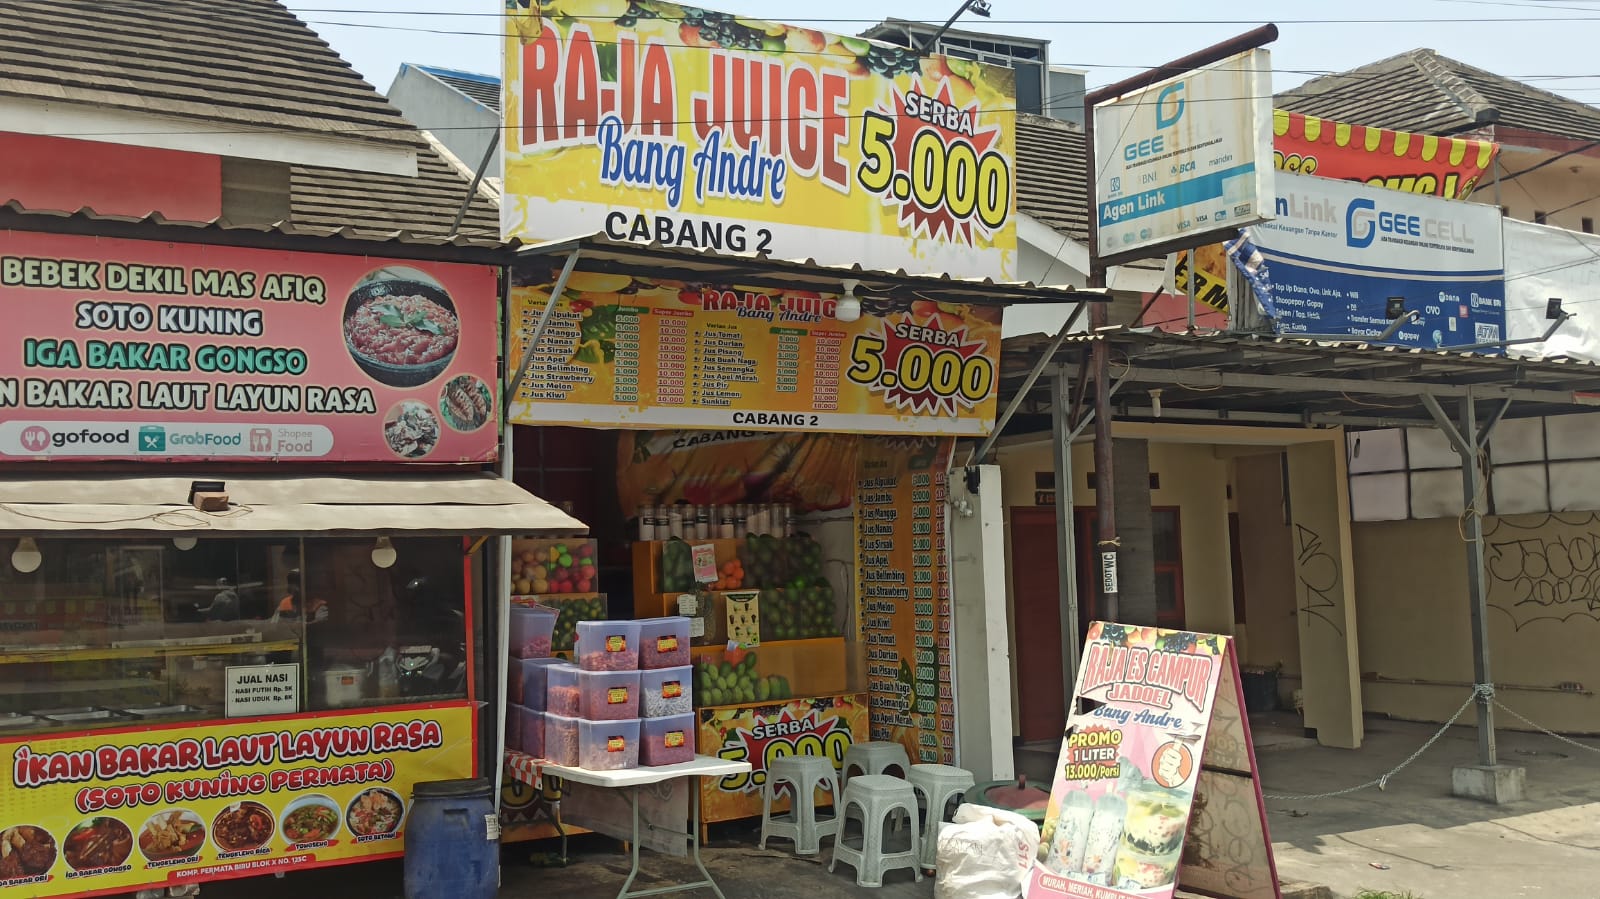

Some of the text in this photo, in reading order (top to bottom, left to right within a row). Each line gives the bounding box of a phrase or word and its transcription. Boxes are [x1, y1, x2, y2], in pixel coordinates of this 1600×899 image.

[522, 26, 850, 192] RAJA JUICE
[906, 91, 974, 136] SERBA
[1124, 135, 1164, 161] GEE
[600, 116, 785, 207] Bang Andre
[1179, 161, 1196, 174] BCA
[1209, 154, 1232, 166] mandiri
[858, 110, 1010, 229] 5.000
[1142, 172, 1157, 184] BNI
[1104, 191, 1165, 220] Agen Link
[605, 211, 772, 254] CABANG 2
[1177, 220, 1190, 230] VISA
[1279, 225, 1304, 233] Keuangan
[1305, 228, 1320, 237] Tanpa
[1379, 211, 1474, 244] GEE CELL
[2, 258, 327, 304] BEBEK DEKIL MAS AFIQ
[1276, 283, 1284, 293] Top
[702, 291, 771, 311] RAJA
[1479, 297, 1492, 306] BANK
[736, 306, 821, 323] Bang Andre
[1426, 305, 1440, 315] OVO
[76, 302, 262, 336] SOTO KUNING
[548, 320, 575, 328] Jambu
[547, 329, 581, 338] Mangga
[894, 322, 961, 348] SERBA
[1404, 332, 1419, 341] gopay
[24, 340, 308, 375] IGA BAKAR GONGSO
[547, 365, 589, 373] Belimbing
[847, 336, 992, 402] 5.000
[547, 374, 594, 383] Strawberry
[24, 380, 376, 413] BAKAR LAUT LAYUN RASA
[733, 412, 819, 426] CABANG 2
[52, 428, 313, 447] gofood GrabFood Shopee
[277, 439, 313, 453] Food
[875, 509, 897, 521] Mangga
[866, 571, 905, 584] Jus Belimbing
[1104, 554, 1114, 591] SEDOT WC
[866, 586, 909, 598] Jus Strawberry
[867, 602, 895, 613] Jus Melon
[868, 634, 895, 644] Jus Tomat
[878, 650, 898, 660] Durian
[237, 673, 288, 684] JUAL NASI
[869, 665, 898, 679] Jus Pisang
[1080, 643, 1213, 713] RAJA ES CAMPUR
[1106, 683, 1173, 709] JADOEL
[1093, 703, 1182, 729] Bang Andre
[752, 718, 814, 740] SERBA
[1068, 730, 1122, 748] PROMO
[13, 720, 442, 787] IKAN BAKAR LAUT LAYUN RASA
[1074, 748, 1114, 762] 1 LITER
[1065, 763, 1120, 781] 13.000/Porsi
[76, 758, 395, 813] (SOTO KUNING PERMATA)
[79, 868, 102, 878] BAKAR
[176, 868, 199, 878] KOMP.
[200, 865, 233, 876] PERMATA
[234, 862, 251, 871] BIRU
[252, 859, 270, 869] BLOK
[278, 857, 290, 865] NO.
[9, 876, 33, 885] BAKAR
[1042, 875, 1066, 892] MURAH,
[1068, 882, 1095, 898] MERIAH,
